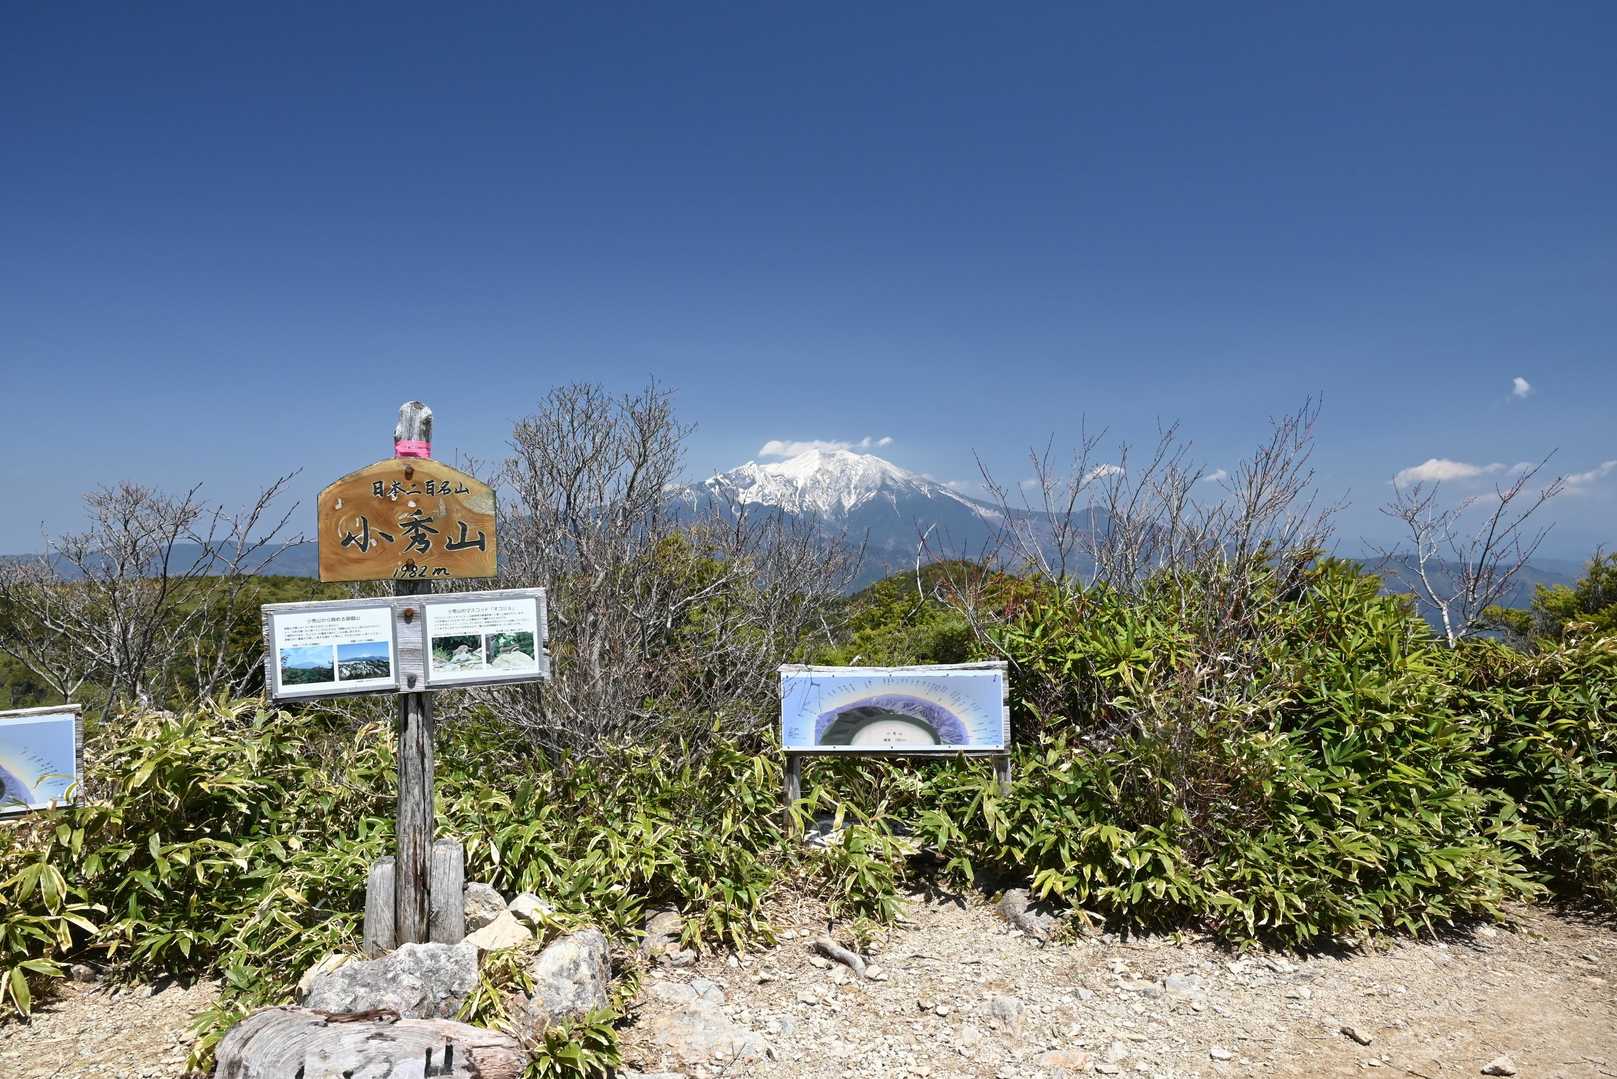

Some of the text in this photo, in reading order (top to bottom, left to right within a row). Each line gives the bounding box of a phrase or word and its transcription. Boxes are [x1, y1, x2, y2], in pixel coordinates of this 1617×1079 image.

[372, 480, 470, 497] 日本二百名山
[341, 509, 486, 553] 小秀山
